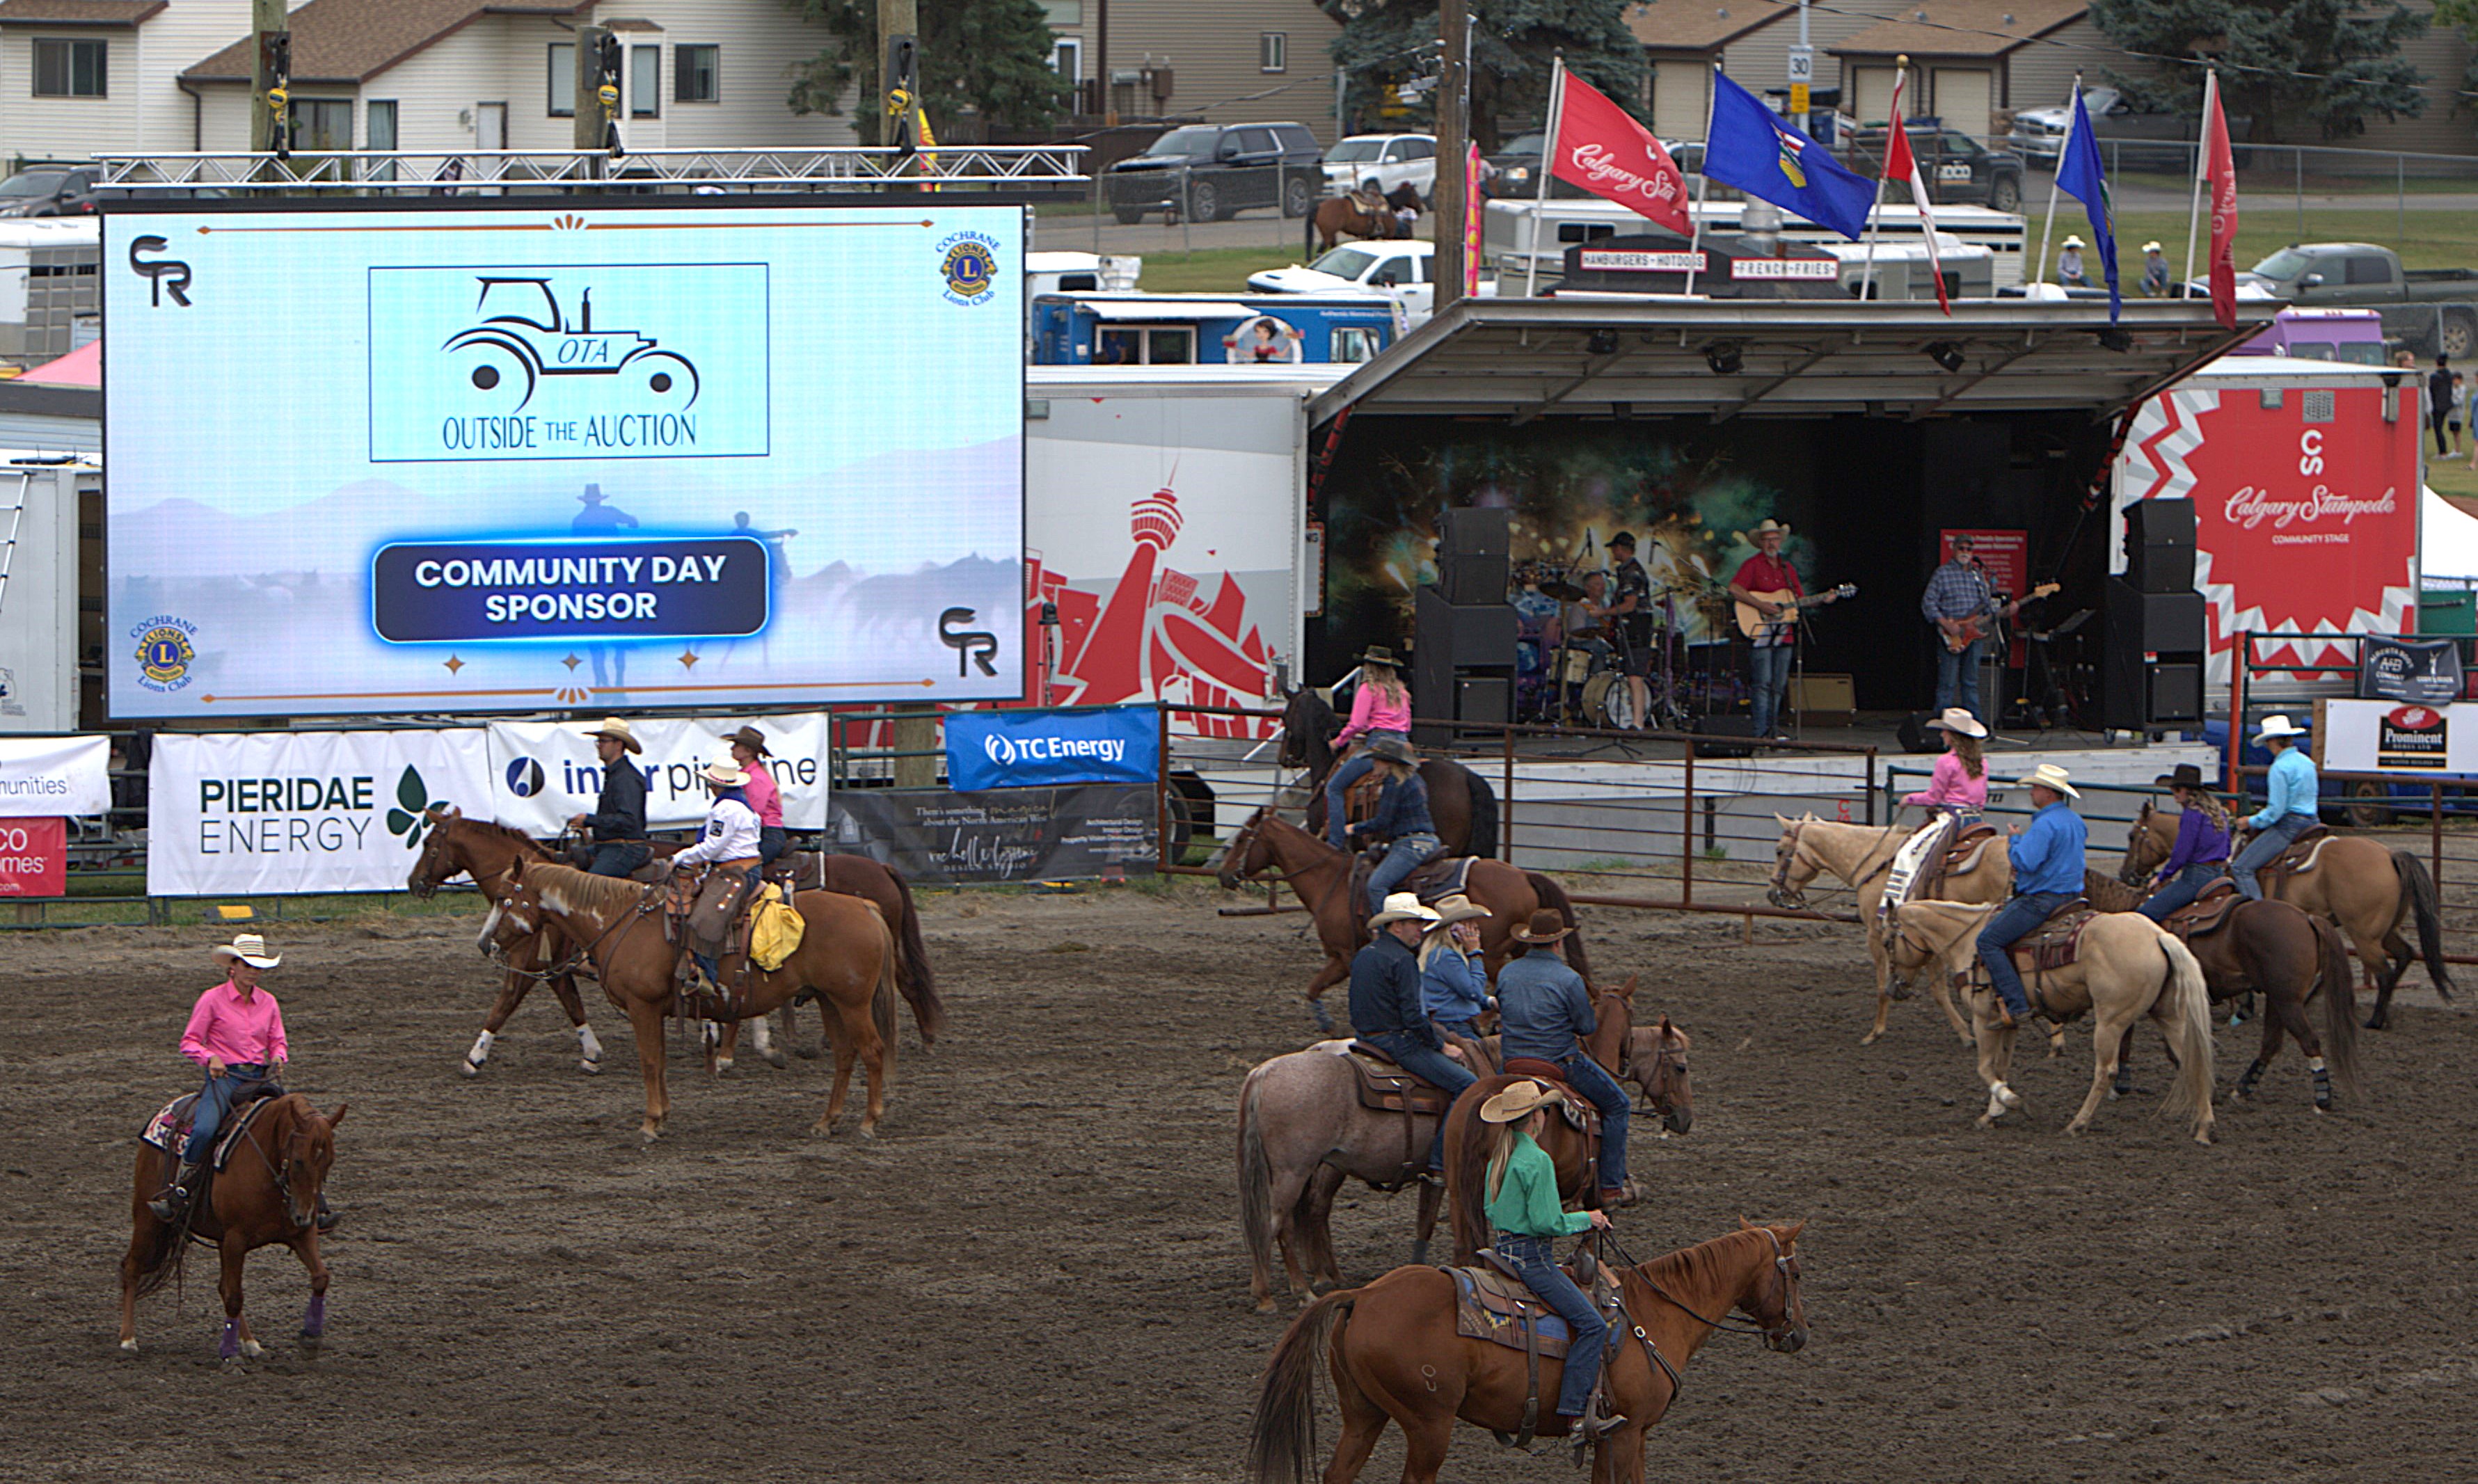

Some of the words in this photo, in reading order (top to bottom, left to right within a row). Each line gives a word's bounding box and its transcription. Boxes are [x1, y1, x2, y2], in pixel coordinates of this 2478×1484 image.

[1792, 58, 1809, 74] 30
[1572, 143, 1644, 192] Calgary
[935, 230, 1001, 253] COCHRANE
[962, 259, 978, 278] L
[558, 339, 608, 364] OTA
[443, 416, 538, 449] OUTSIDE
[544, 422, 578, 440] THE
[584, 414, 697, 447] AUCTION
[2225, 486, 2301, 529] Calgary
[2299, 484, 2396, 525] Stampede
[2272, 534, 2324, 545] COMMUNITY
[2324, 533, 2349, 543] STAGE
[415, 556, 644, 587] COMMUNITY
[651, 554, 727, 583] DAY
[486, 592, 658, 622] SPONSOR
[129, 614, 198, 639] COCHRANE
[146, 628, 184, 642] LIONS
[157, 644, 174, 664] L
[137, 676, 166, 692] Lions
[168, 675, 192, 692] Club
[2385, 727, 2443, 744] Prominent
[1015, 738, 1047, 759] TC
[1047, 737, 1126, 762] Energy
[563, 759, 660, 795] inr
[200, 776, 374, 813] PIERIDAE
[201, 817, 372, 854] ENERGY
